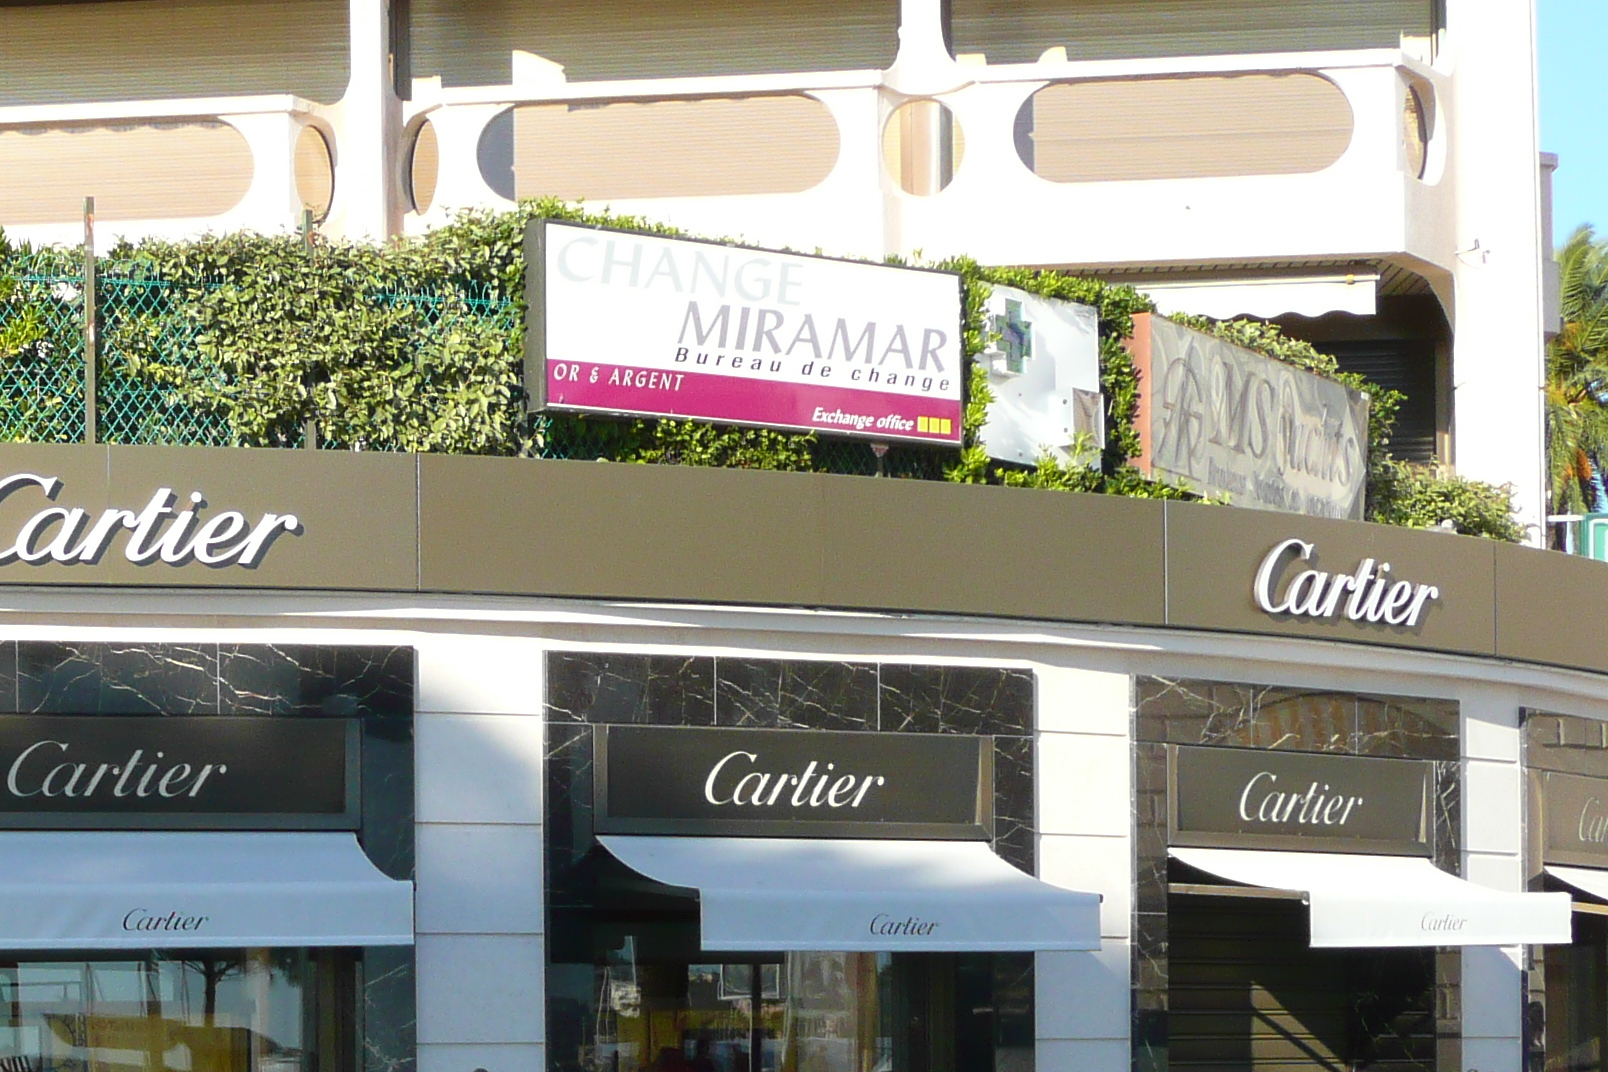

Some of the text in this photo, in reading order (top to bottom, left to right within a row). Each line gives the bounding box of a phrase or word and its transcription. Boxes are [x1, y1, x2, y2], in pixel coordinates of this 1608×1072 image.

[557, 235, 805, 306] CHANGE
[676, 300, 948, 374] MIRAMAR
[553, 363, 686, 392] OR & ARGENT
[674, 346, 951, 393] Bureau de change
[811, 406, 915, 432] Exchange office
[1253, 537, 1441, 628] Cartier
[6, 740, 228, 799] Cartier
[703, 750, 885, 809] Cartier
[1238, 771, 1364, 826] Cartier
[121, 906, 210, 933] Cartier
[868, 912, 940, 937] Cartier
[1419, 911, 1468, 932] Cartier
